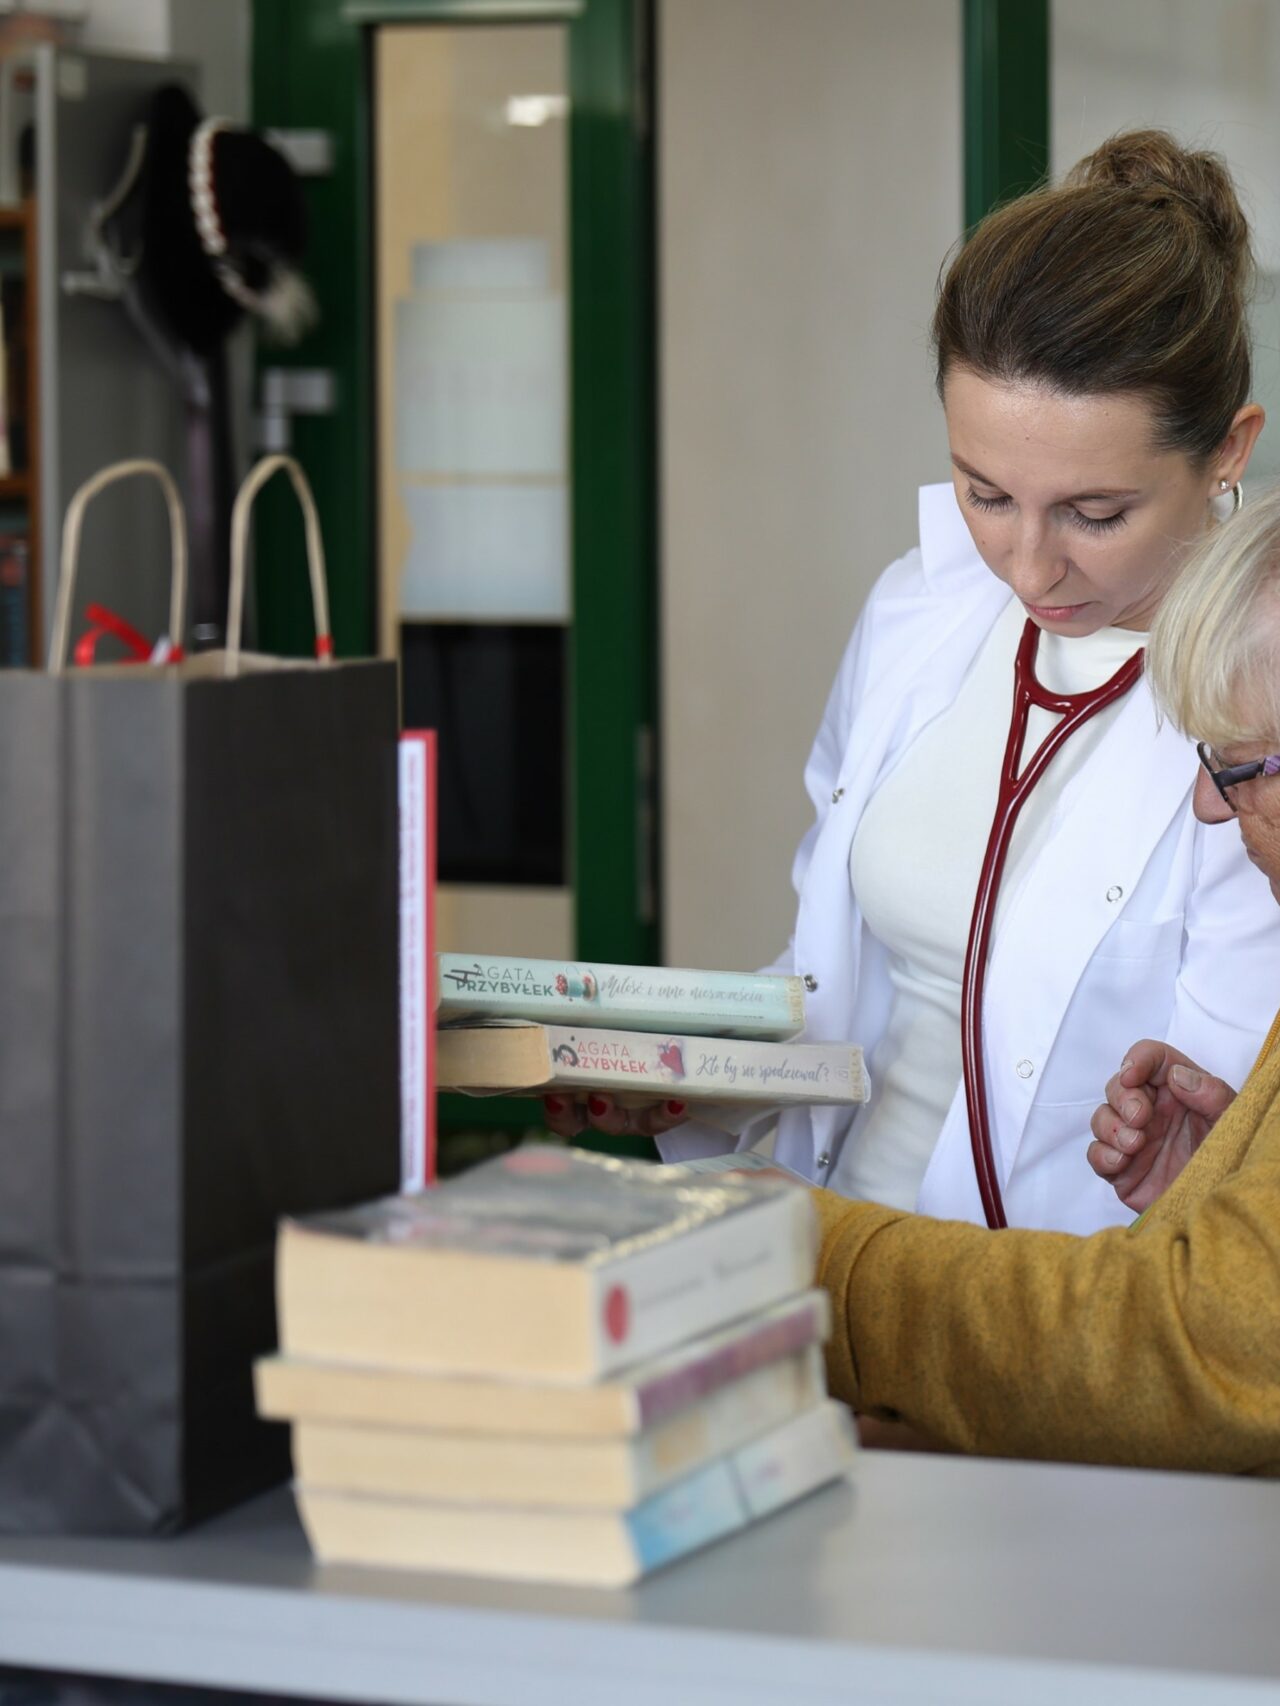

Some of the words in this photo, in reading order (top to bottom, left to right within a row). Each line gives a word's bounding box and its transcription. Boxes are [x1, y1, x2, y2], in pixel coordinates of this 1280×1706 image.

[474, 964, 536, 982] AGATA
[456, 979, 554, 997] PRZYBYŁEK
[577, 1041, 631, 1058] AGATA
[696, 1053, 720, 1077] Kto
[724, 1055, 737, 1083] by
